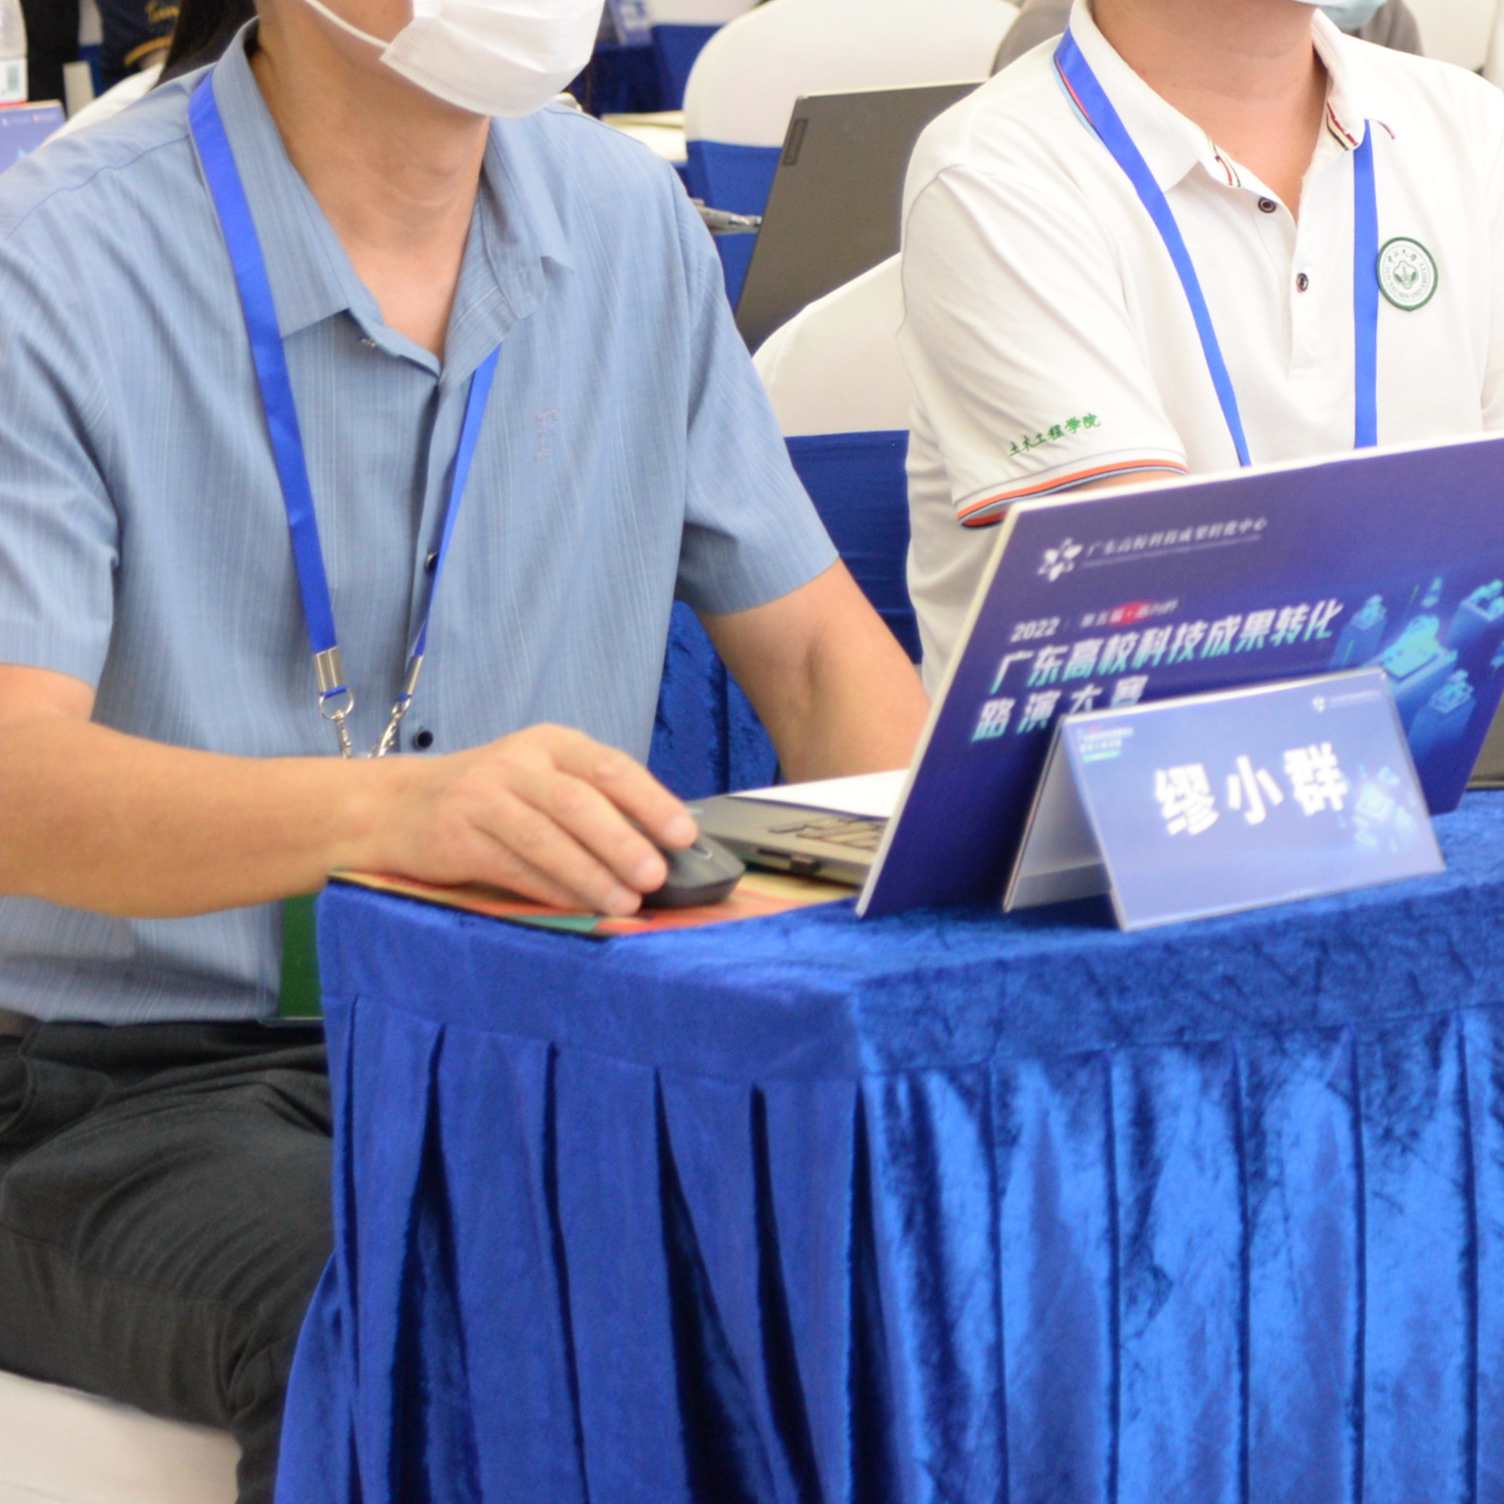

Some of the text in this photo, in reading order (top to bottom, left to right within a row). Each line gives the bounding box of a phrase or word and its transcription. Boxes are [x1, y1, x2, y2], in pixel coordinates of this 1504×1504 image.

[988, 597, 1344, 695] 广东高校科技成果转化
[1011, 616, 1060, 643] 2022
